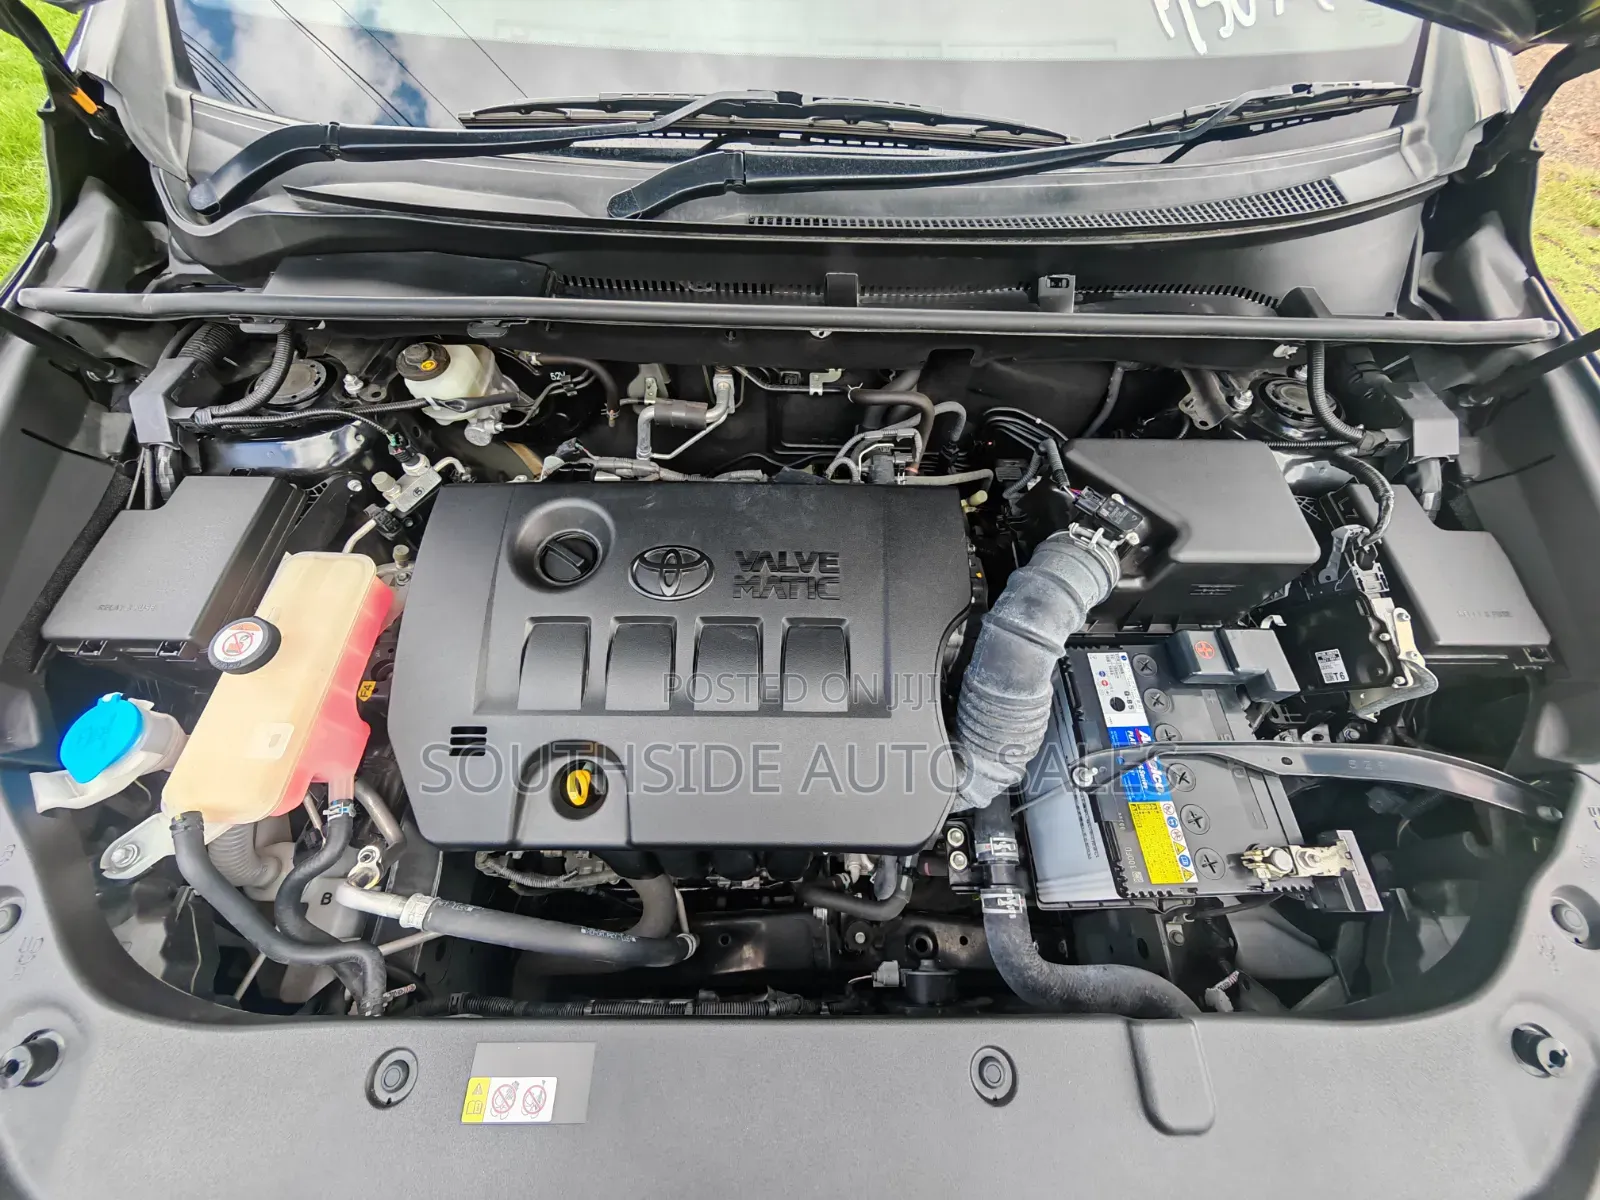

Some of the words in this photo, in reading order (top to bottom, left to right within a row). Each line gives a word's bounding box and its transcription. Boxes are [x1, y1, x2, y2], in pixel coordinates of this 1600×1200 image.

[734, 550, 840, 574] VALVE
[733, 575, 841, 601] MATIC
[360, 684, 373, 698] F4
[320, 892, 333, 906] B
